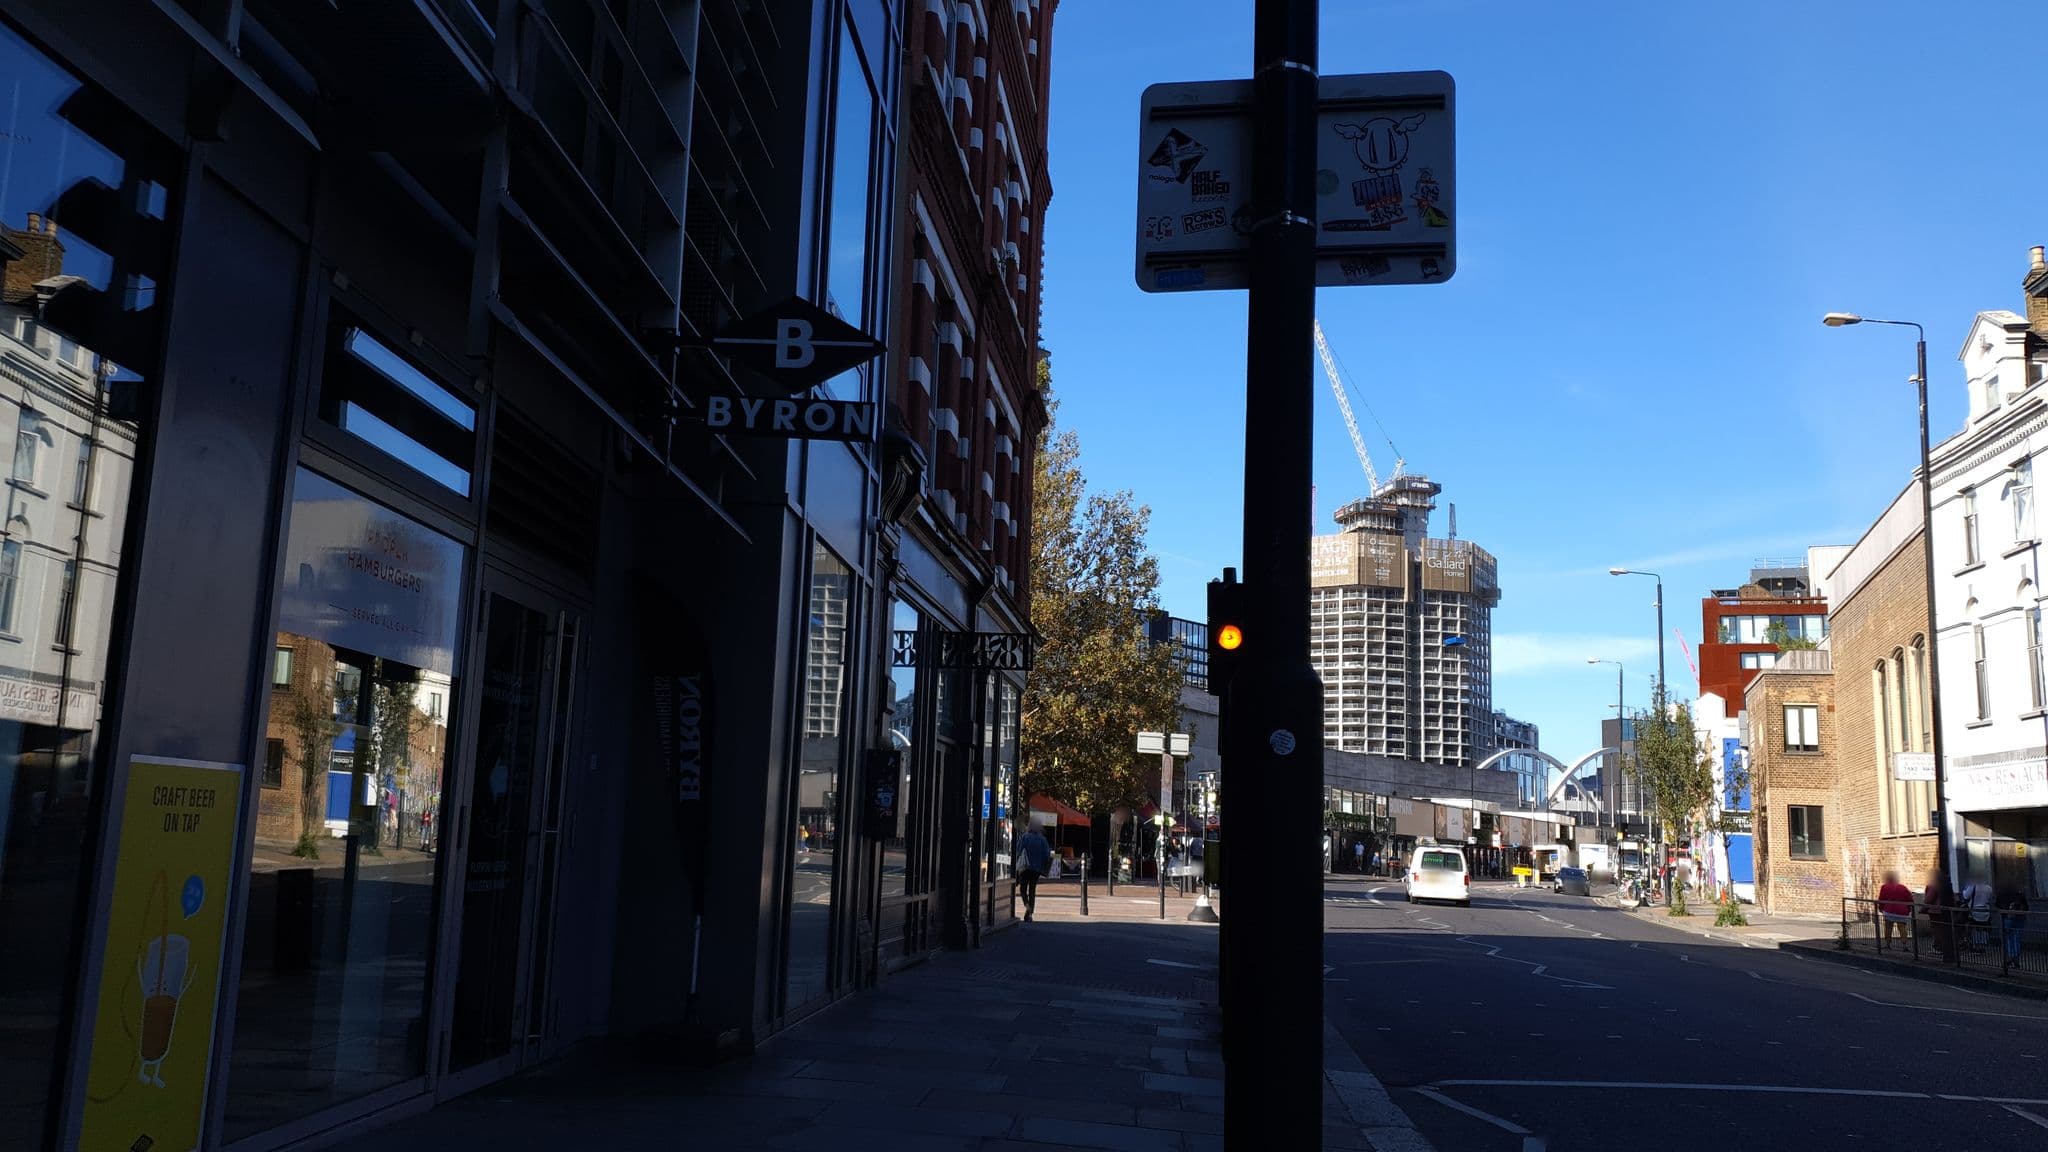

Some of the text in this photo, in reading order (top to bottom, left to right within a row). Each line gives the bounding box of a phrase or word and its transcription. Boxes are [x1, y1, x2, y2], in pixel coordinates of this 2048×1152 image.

[1191, 171, 1221, 183] HALF
[1191, 182, 1231, 195] BAKED
[775, 318, 816, 369] B
[706, 395, 872, 436] BYRON
[347, 549, 423, 593] HAMBURGERS
[1443, 569, 1466, 578] Homes
[152, 785, 216, 808] CRAFT BEER
[163, 813, 201, 833] ON TAP
